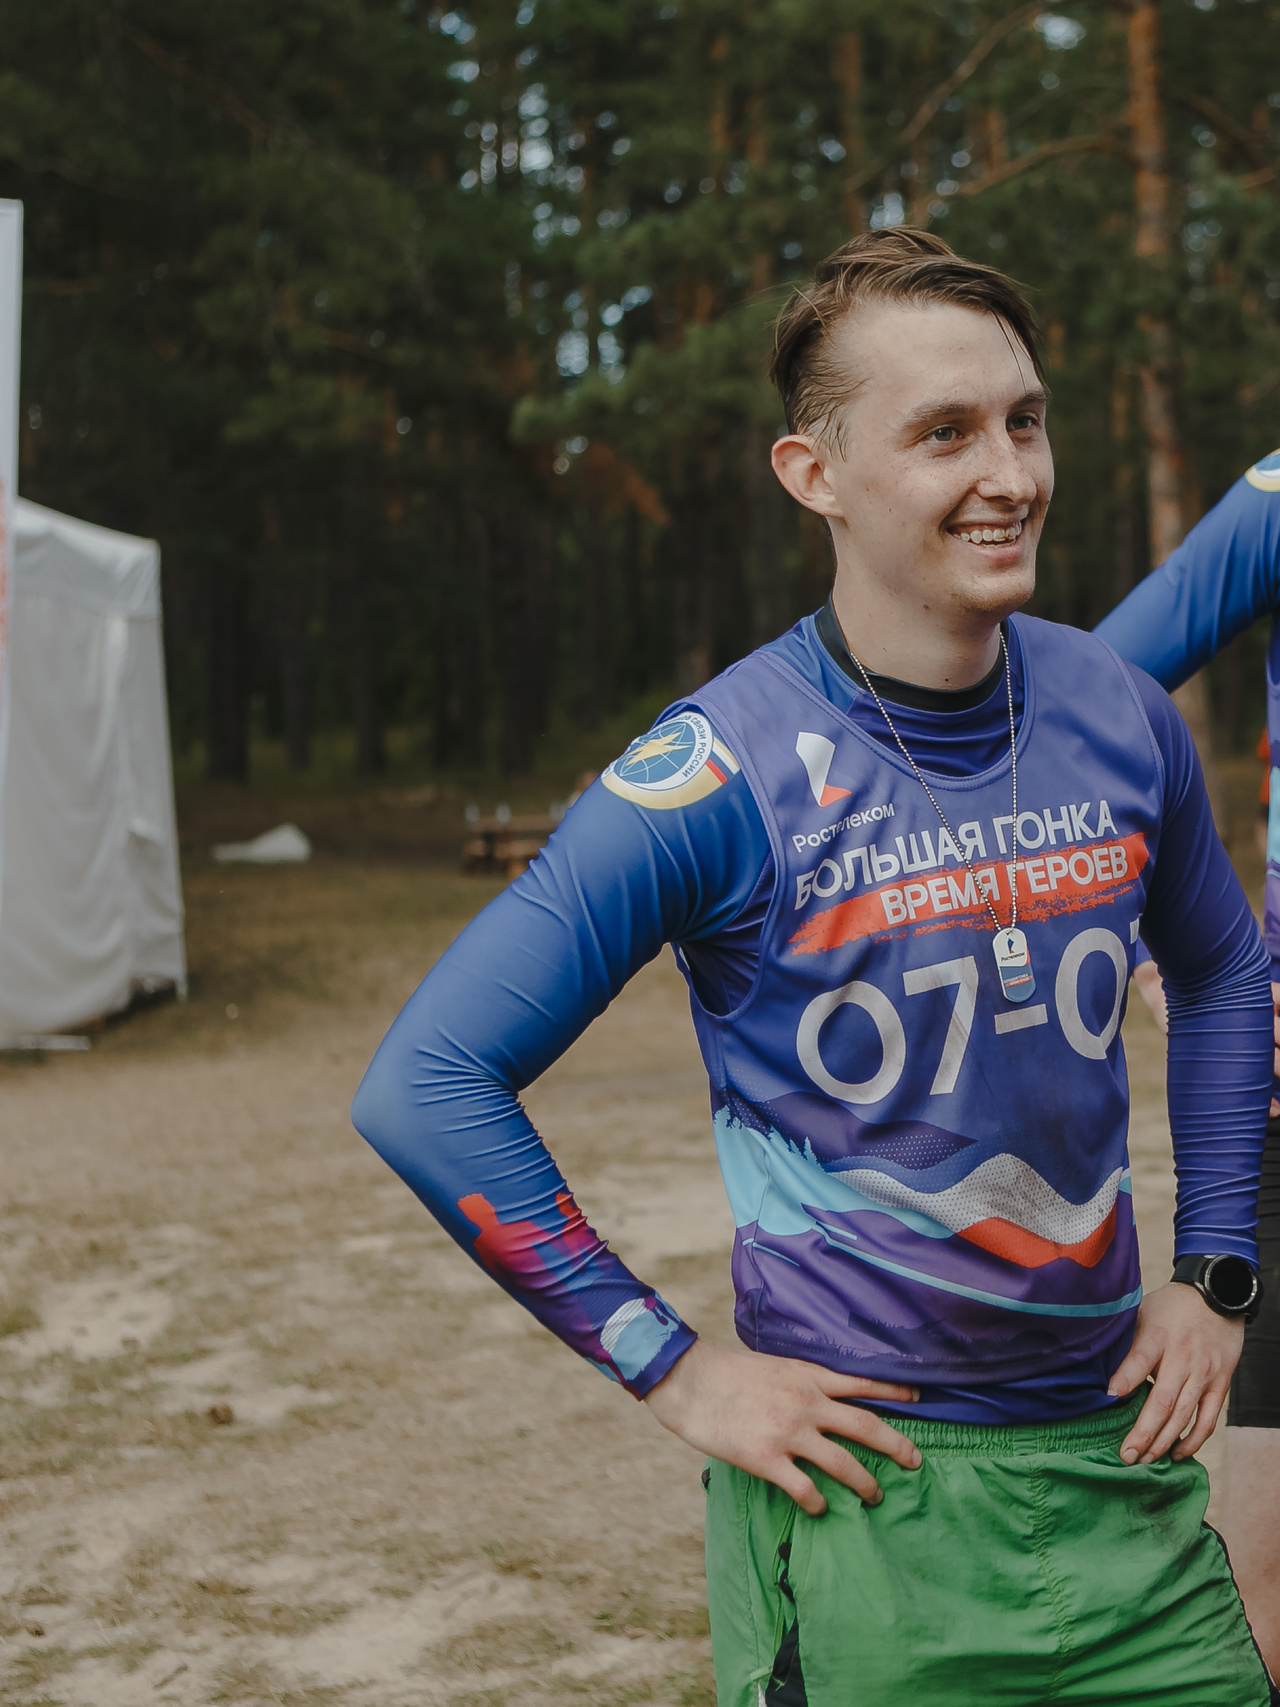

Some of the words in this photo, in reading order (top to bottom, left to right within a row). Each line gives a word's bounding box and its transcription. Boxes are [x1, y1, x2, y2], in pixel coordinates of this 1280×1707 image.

[682, 742, 707, 778] РОССИИ
[792, 802, 895, 854] Ростелеком
[794, 820, 987, 911] БОЛЬШАЯ
[992, 800, 1119, 855] ГОНКА
[880, 867, 999, 925] ВРЕМЯ
[1006, 845, 1129, 897] ГЕРОЕВ
[796, 913, 1142, 1105] 07-0
